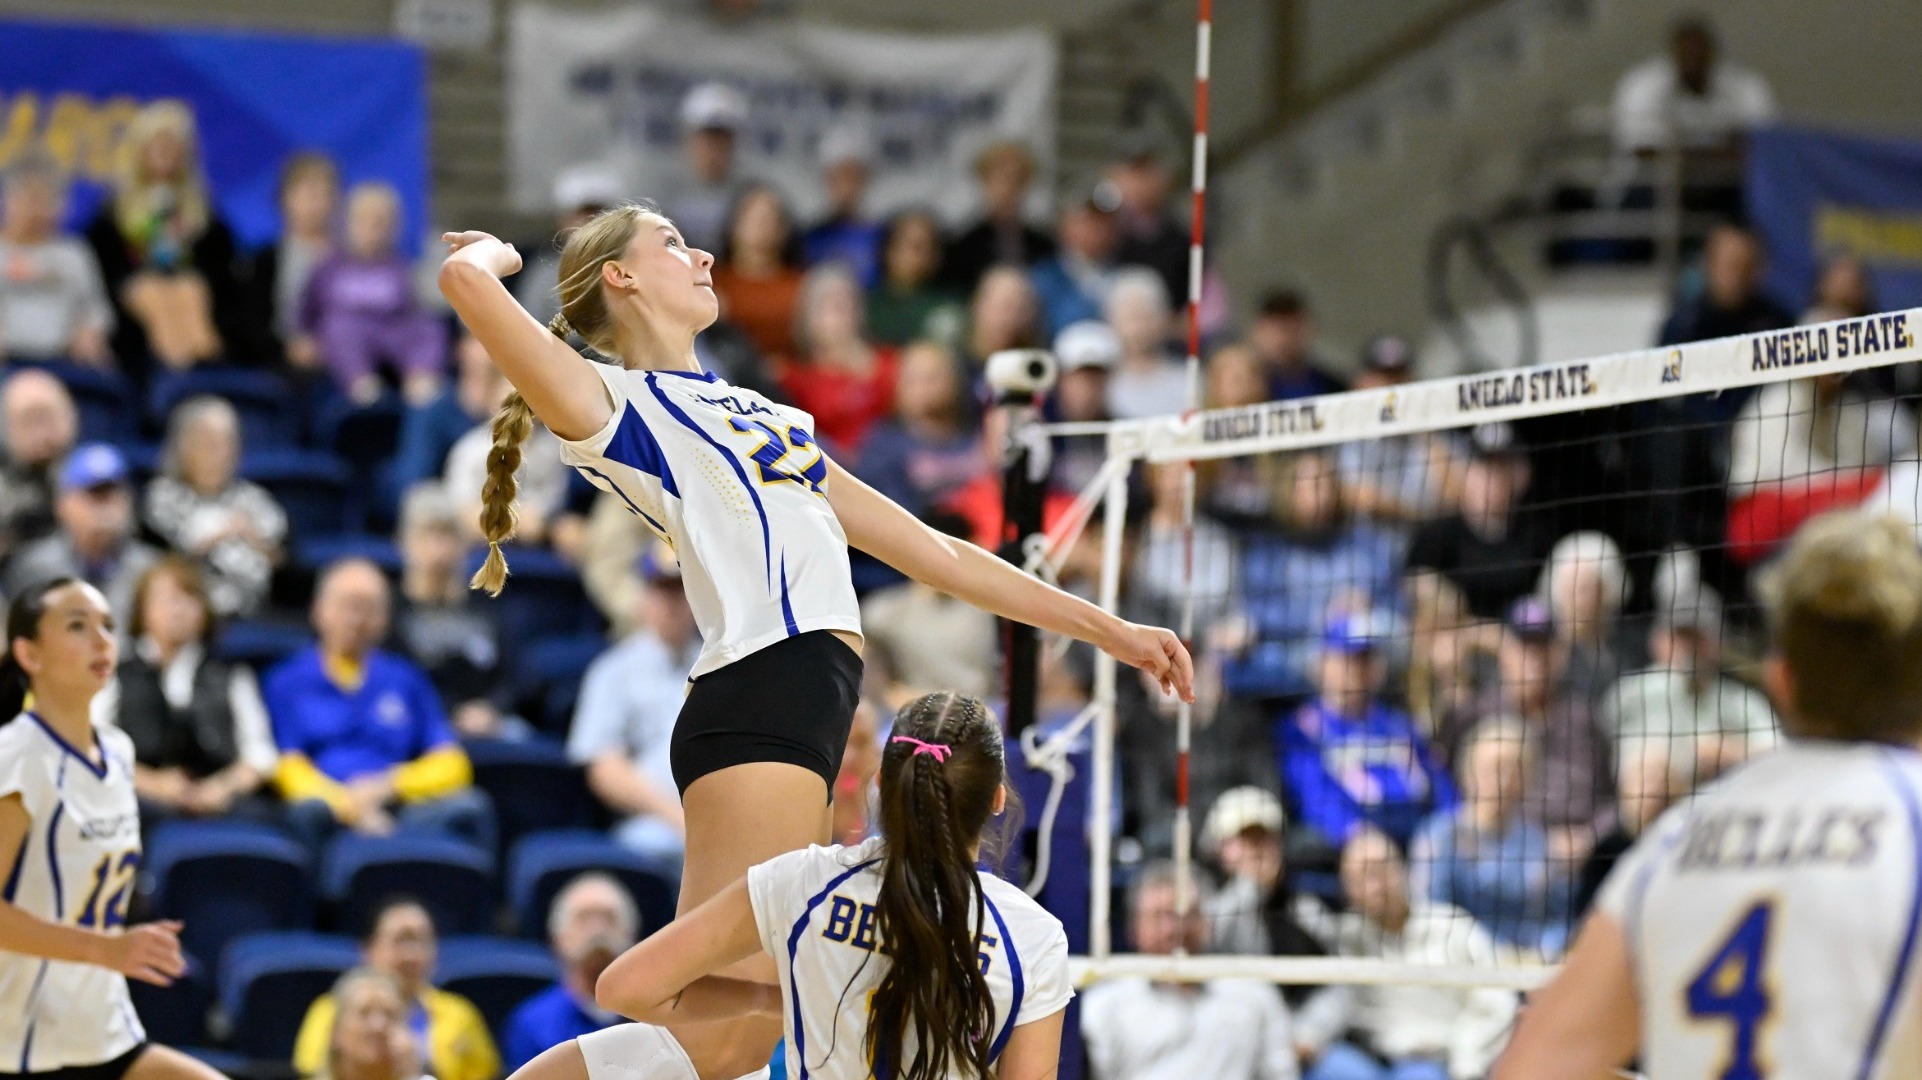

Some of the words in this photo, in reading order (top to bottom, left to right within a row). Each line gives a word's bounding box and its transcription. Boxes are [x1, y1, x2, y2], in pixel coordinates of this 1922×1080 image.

[1752, 327, 1829, 371] ANGELO
[724, 413, 828, 491] 22
[74, 850, 138, 931] 12
[1678, 893, 1785, 1080] 4
